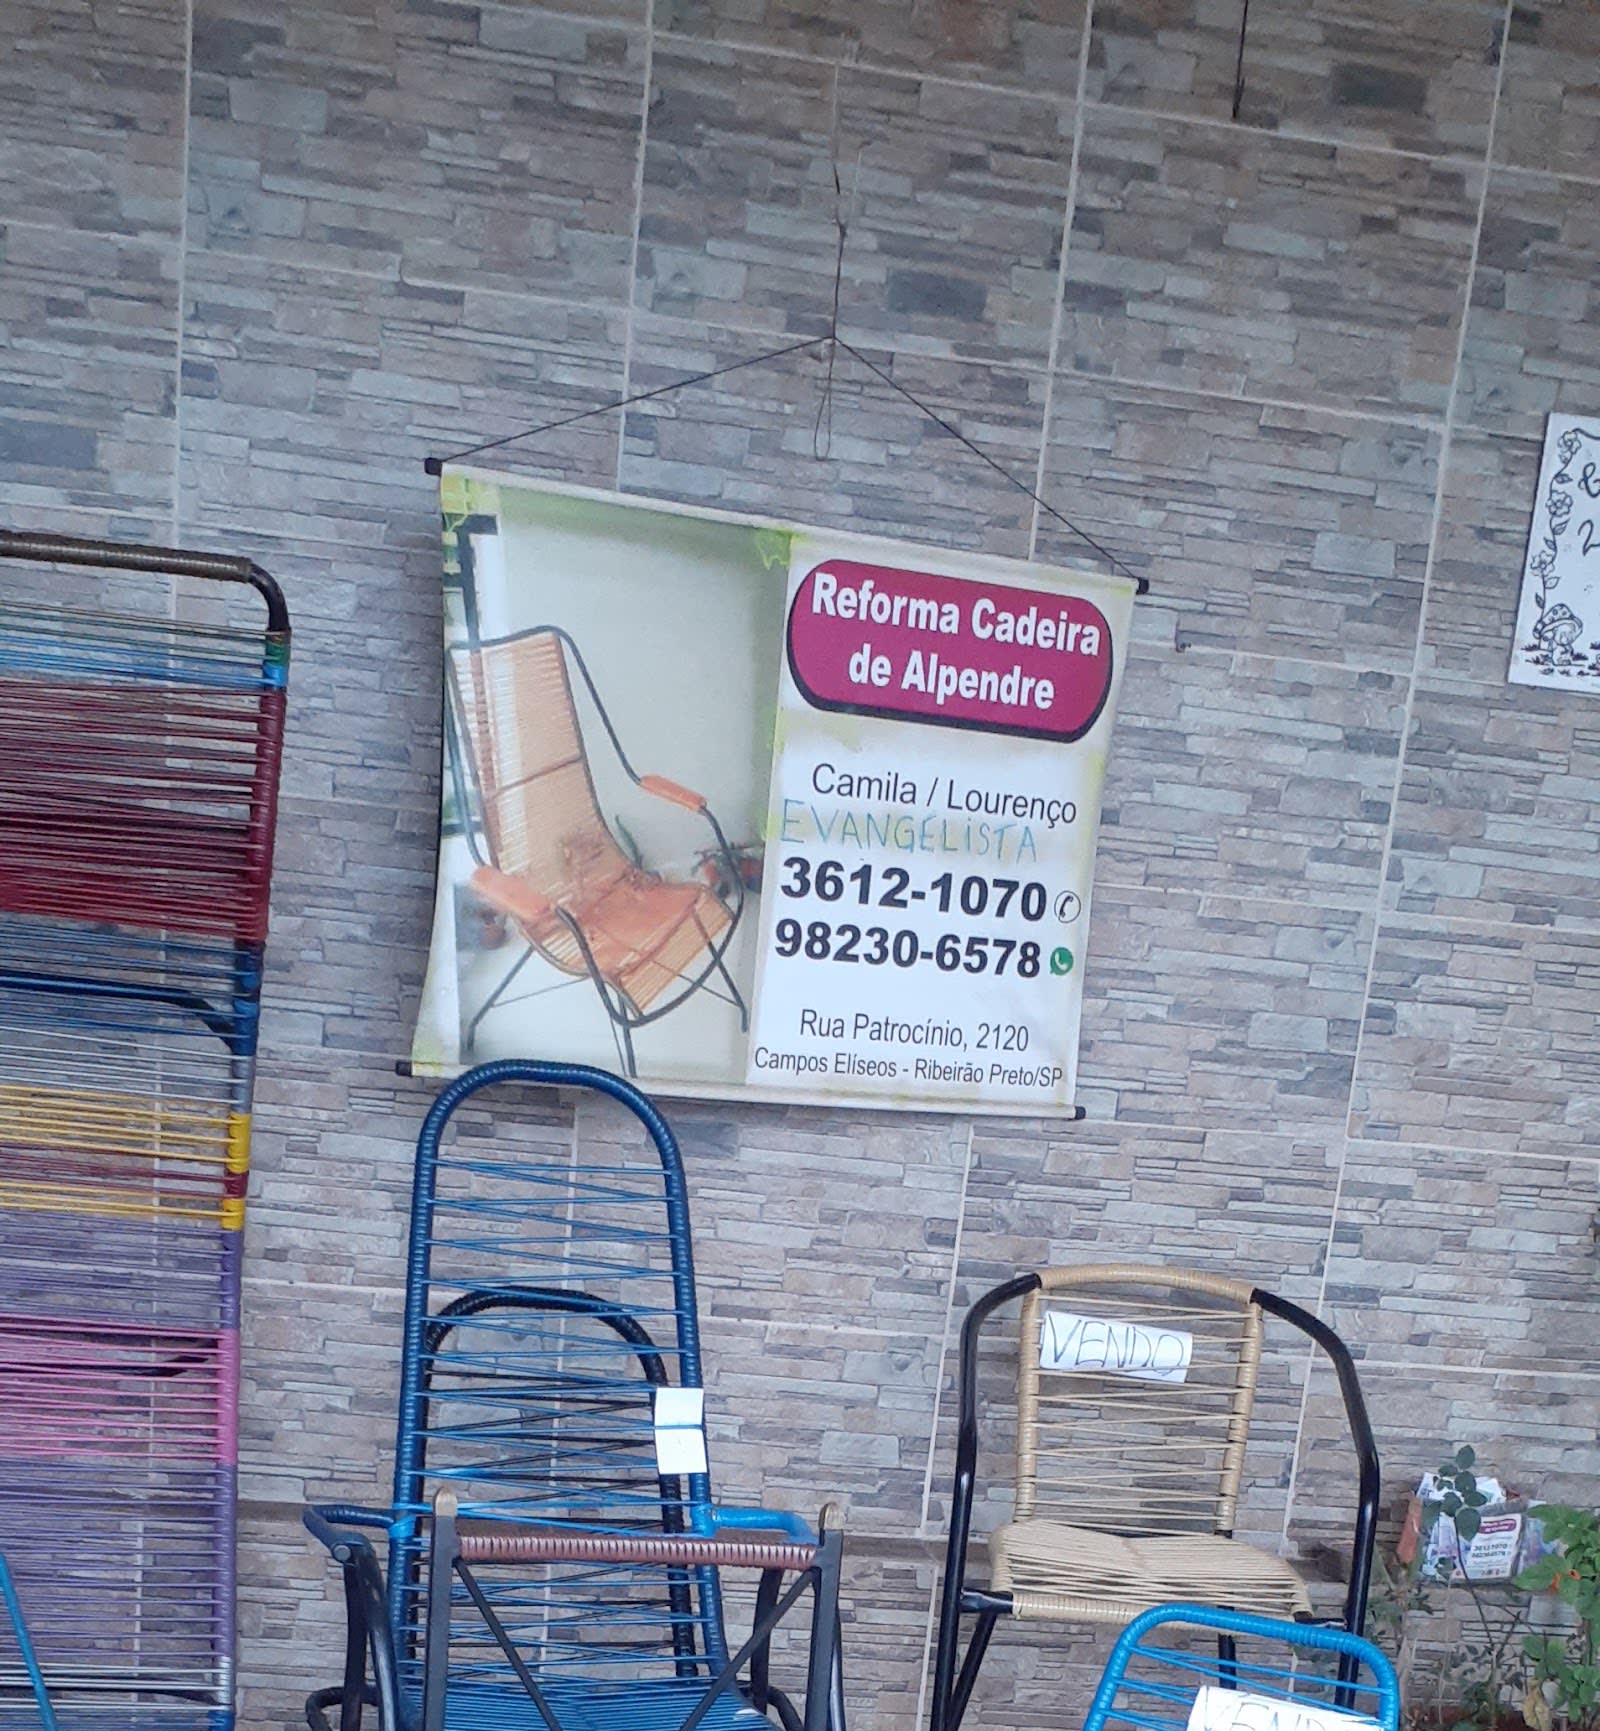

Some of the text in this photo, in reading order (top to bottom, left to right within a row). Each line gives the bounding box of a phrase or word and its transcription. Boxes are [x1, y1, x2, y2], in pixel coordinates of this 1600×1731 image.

[812, 572, 1101, 656] Reforma Cadeira
[849, 643, 1055, 710] de Alpendre
[812, 763, 917, 804] Camila
[947, 779, 1077, 829] Lourenço
[780, 856, 1048, 922] 3612-1070
[775, 918, 1042, 978] 98230-6578
[800, 1008, 1029, 1051] Rua Patrocínio, 2120
[754, 1047, 828, 1076] Campos
[834, 1052, 897, 1077] Elíseos
[914, 1058, 984, 1084] Ribeirão
[989, 1064, 1063, 1088] Preto/SP
[1047, 1313, 1185, 1377] VENDO
